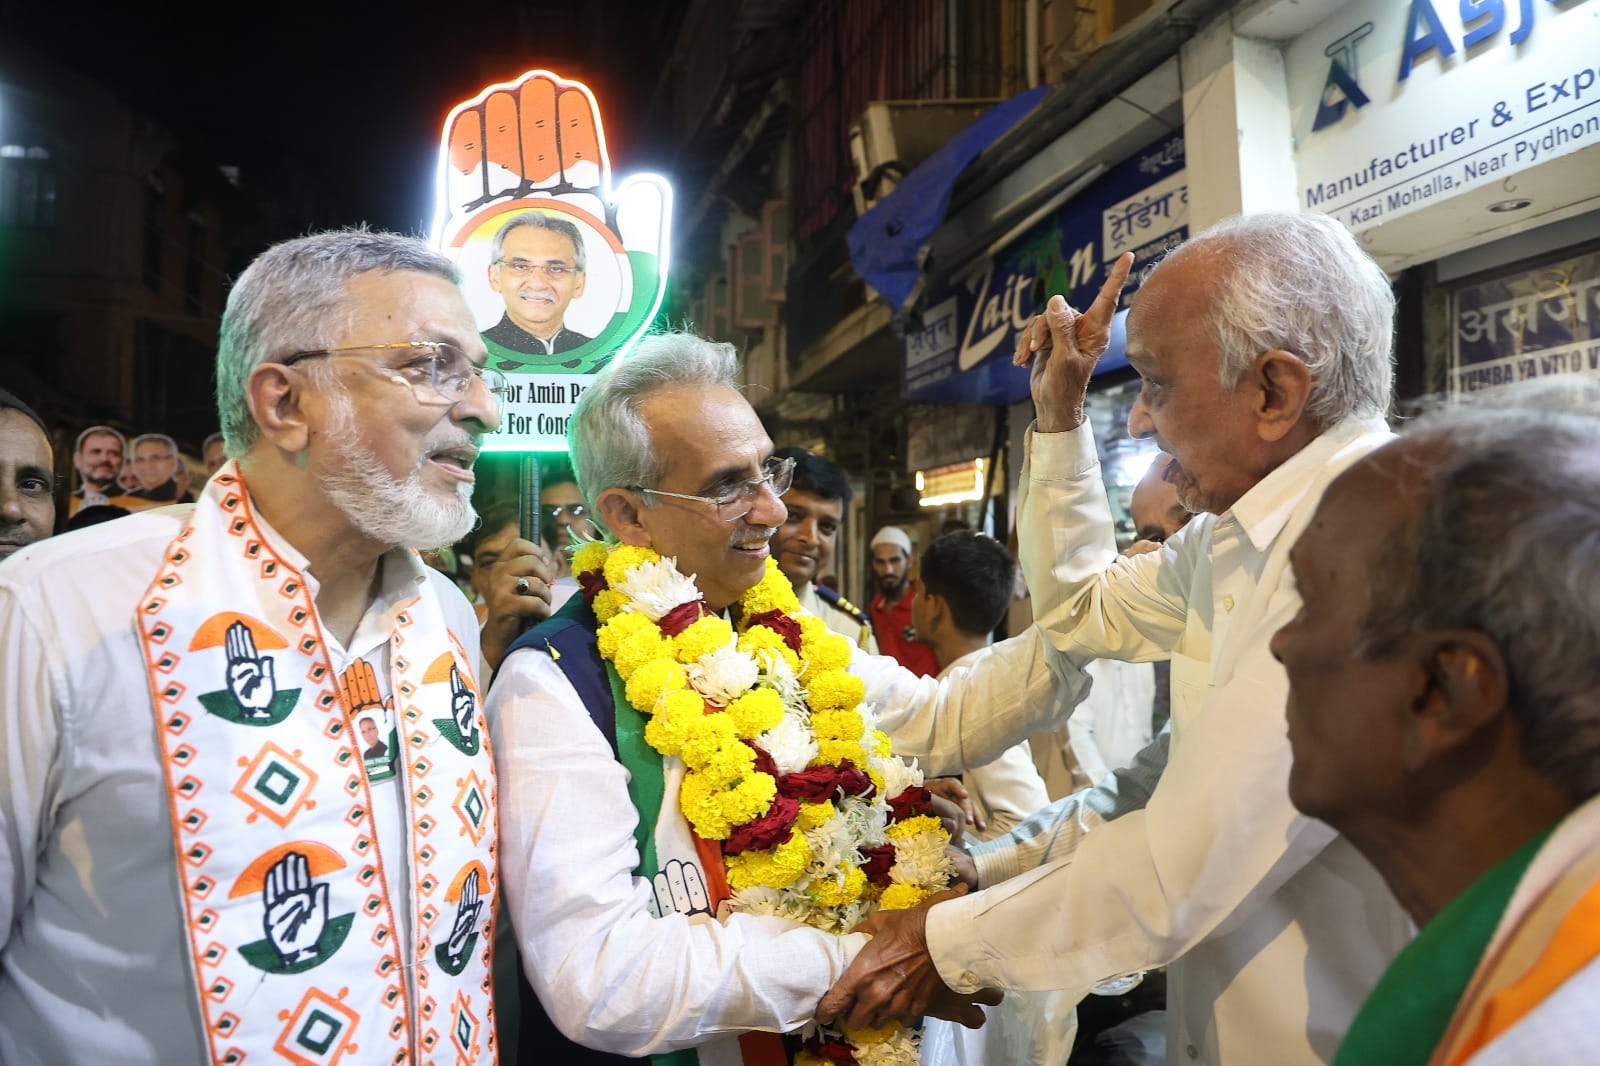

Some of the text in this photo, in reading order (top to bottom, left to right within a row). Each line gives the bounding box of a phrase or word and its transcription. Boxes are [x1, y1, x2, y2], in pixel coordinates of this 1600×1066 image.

[1397, 0, 1567, 83] Asj
[1305, 68, 1600, 208] Manufacturer & Exp
[1350, 200, 1383, 226] Kazi
[1387, 174, 1461, 212] Mohalla,
[1464, 152, 1508, 182] Near
[507, 382, 588, 404] or Amin P
[508, 413, 532, 435] For
